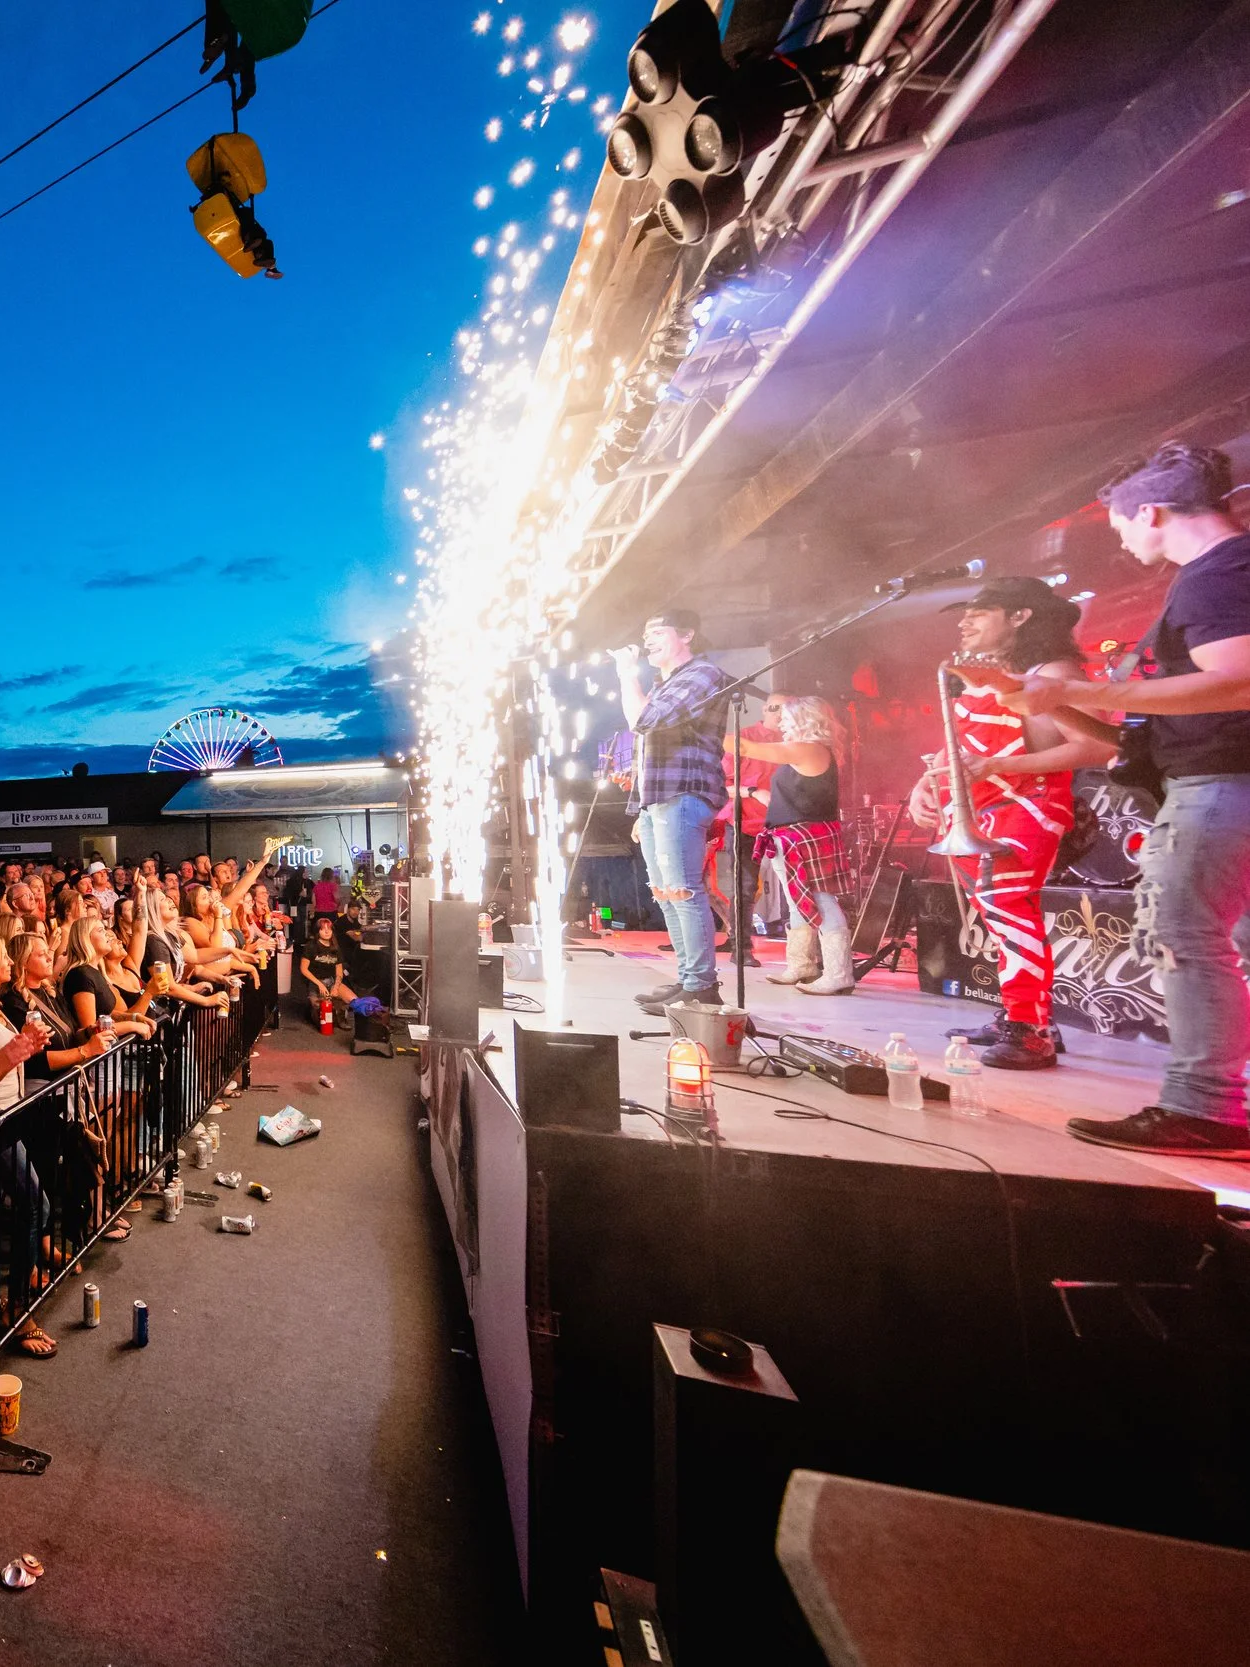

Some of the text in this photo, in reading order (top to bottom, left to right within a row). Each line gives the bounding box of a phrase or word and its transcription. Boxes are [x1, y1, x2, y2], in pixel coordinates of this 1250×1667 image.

[11, 813, 31, 826] Lite
[32, 814, 58, 822] SPORTS
[59, 813, 74, 821] BAR
[964, 986, 1003, 1005] bellacai
